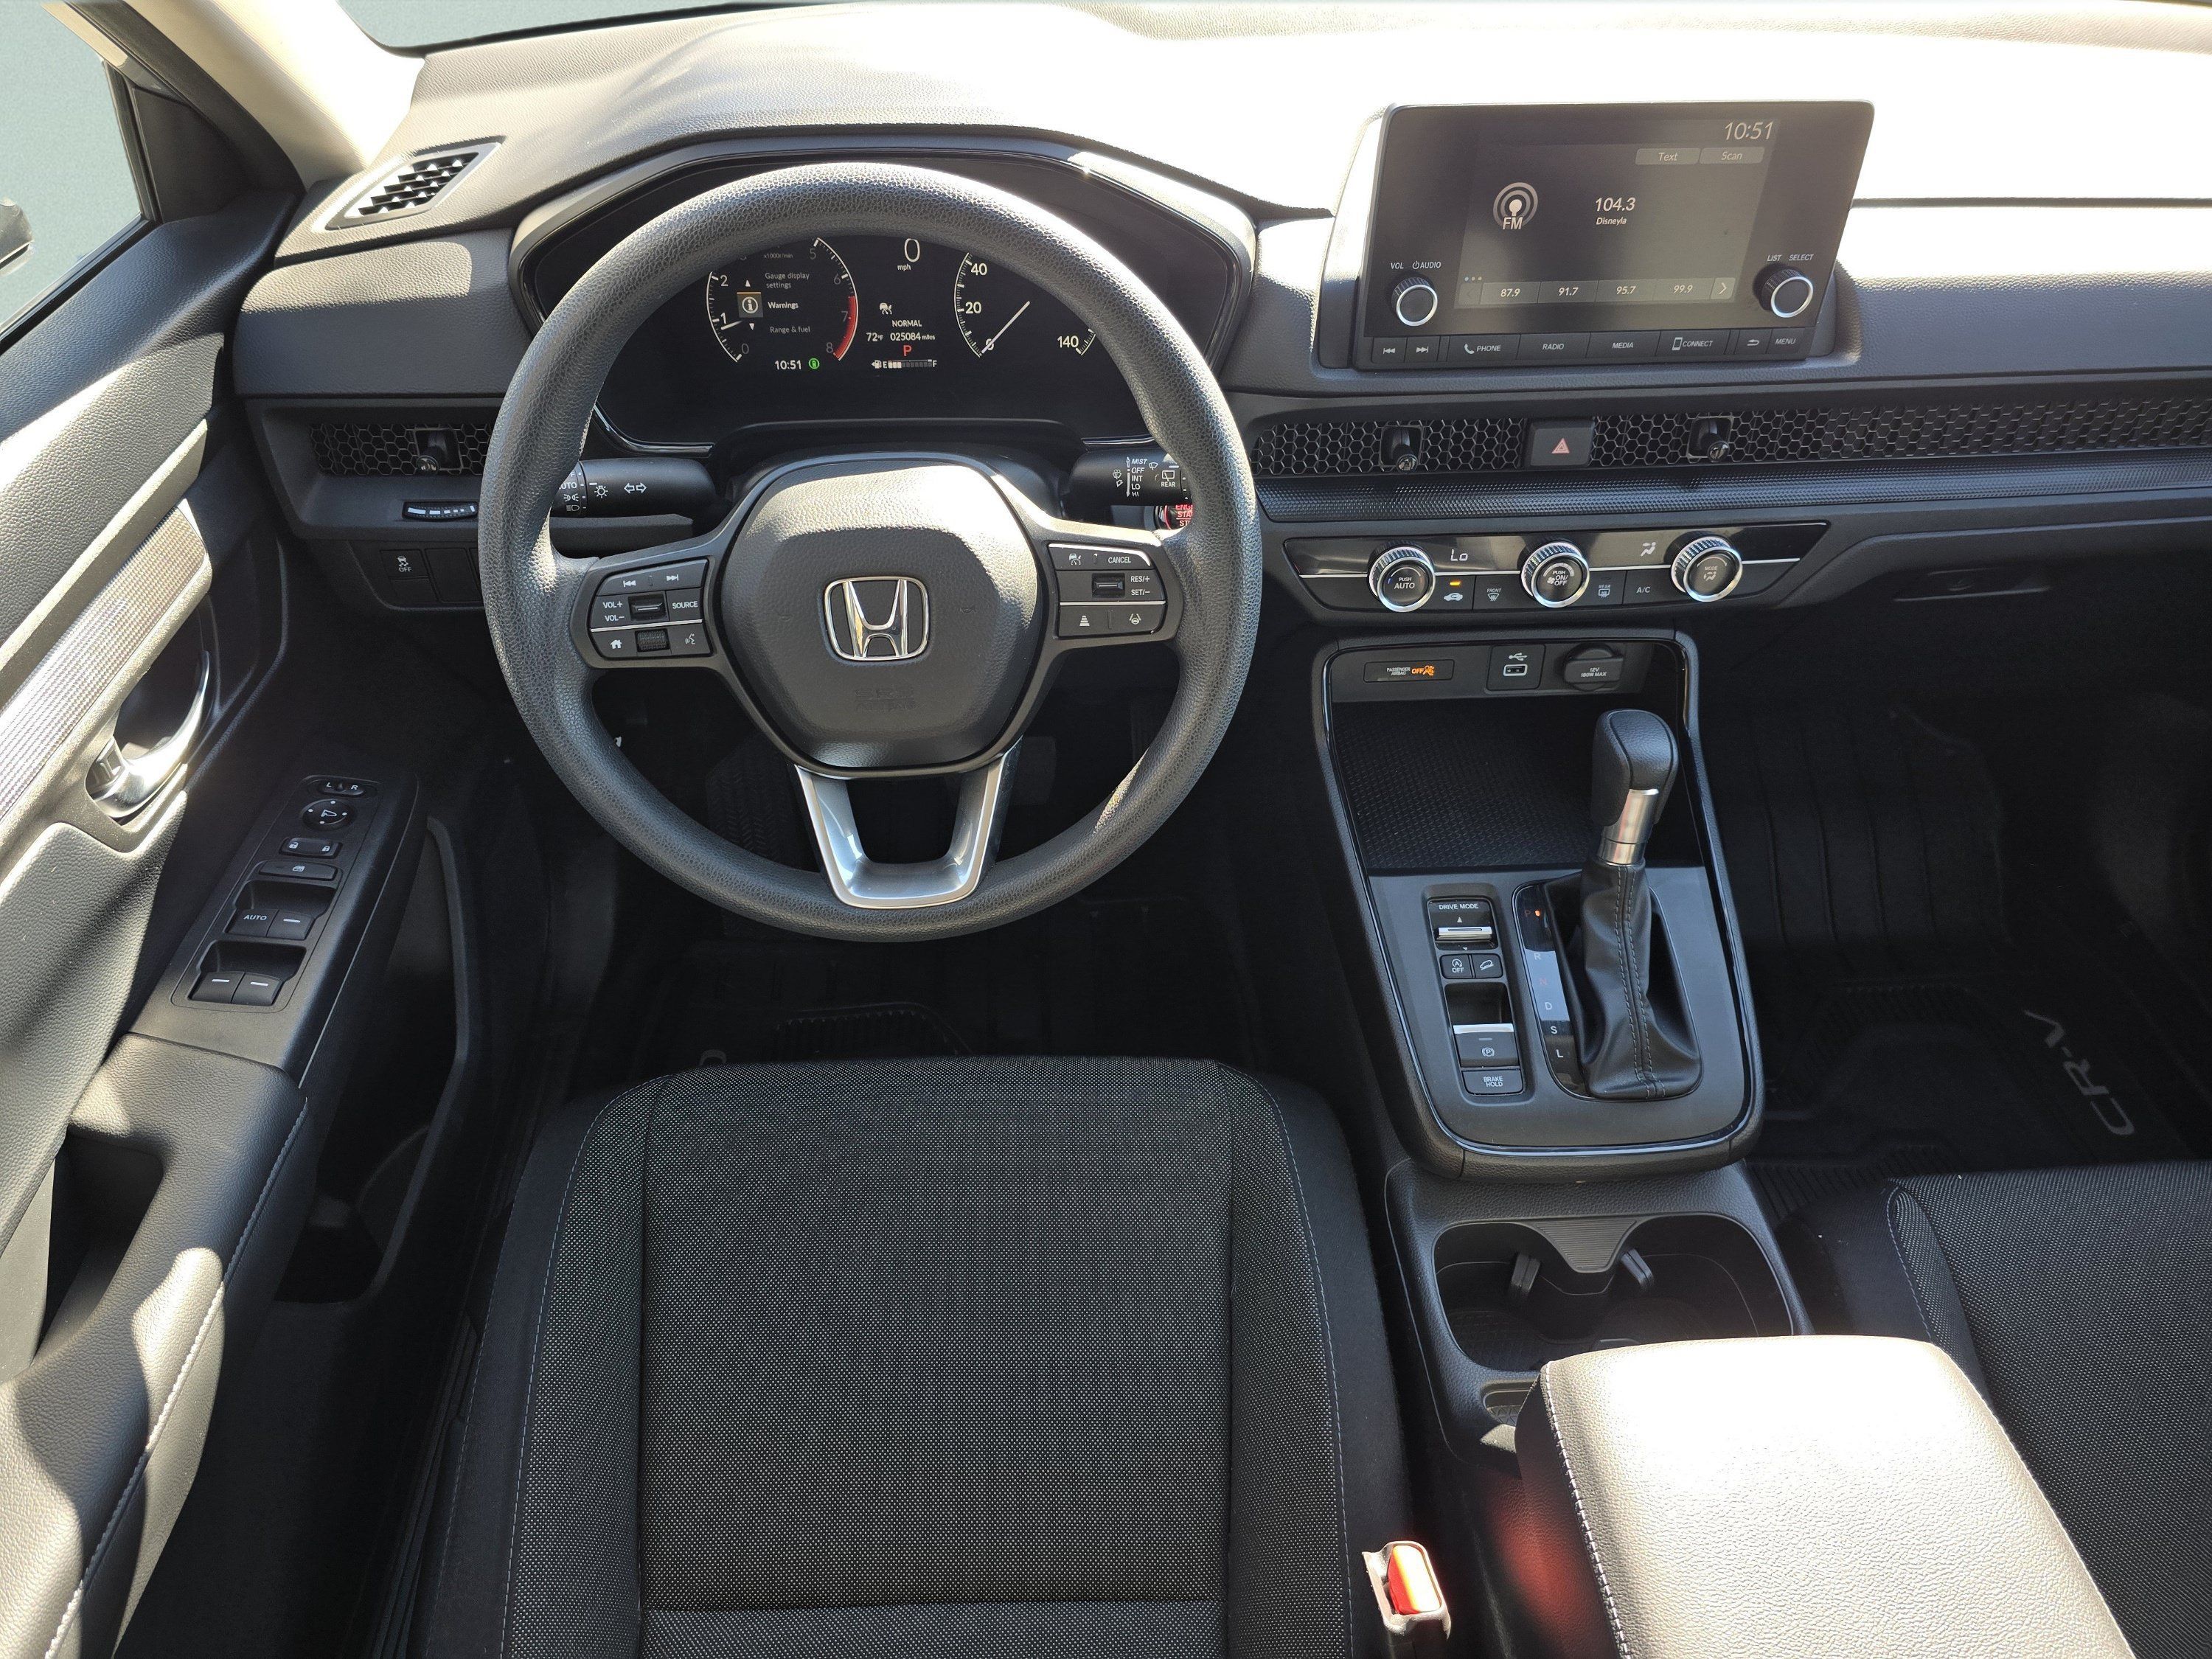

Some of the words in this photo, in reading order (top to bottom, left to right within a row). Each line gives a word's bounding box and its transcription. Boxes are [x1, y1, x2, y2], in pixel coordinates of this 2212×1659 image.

[1724, 121, 1774, 141] 10:51
[1658, 152, 1677, 161] Text
[1721, 151, 1742, 161] Scan
[1595, 197, 1636, 212] 104.3
[1502, 216, 1523, 230] FM
[1596, 217, 1627, 226] Disneyla
[904, 238, 920, 262] 0
[971, 262, 988, 276] 40
[720, 275, 728, 286] 2
[834, 275, 841, 285] 6
[1500, 288, 1520, 298] 87.9
[1558, 287, 1579, 296] 91.7
[1615, 285, 1636, 295] 95.7
[1673, 285, 1693, 293] 99.9
[768, 302, 799, 310] Warnings
[965, 302, 982, 314] 20
[720, 313, 726, 324] 1
[890, 333, 921, 341] 025084
[1057, 335, 1079, 348] 140
[742, 344, 749, 354] 0
[826, 342, 833, 353] 8
[903, 345, 912, 357] P
[1476, 344, 1501, 352] PHONE
[1543, 343, 1565, 351] RADIO
[775, 361, 801, 369] 10:51
[559, 481, 577, 490] UTO
[1394, 582, 1416, 590] AUTO
[672, 601, 698, 609] SOURCE
[1545, 1002, 1553, 1010] D
[1551, 1026, 1558, 1034] S
[1557, 1049, 1564, 1058] L
[2024, 1009, 2135, 1135] CR-V
